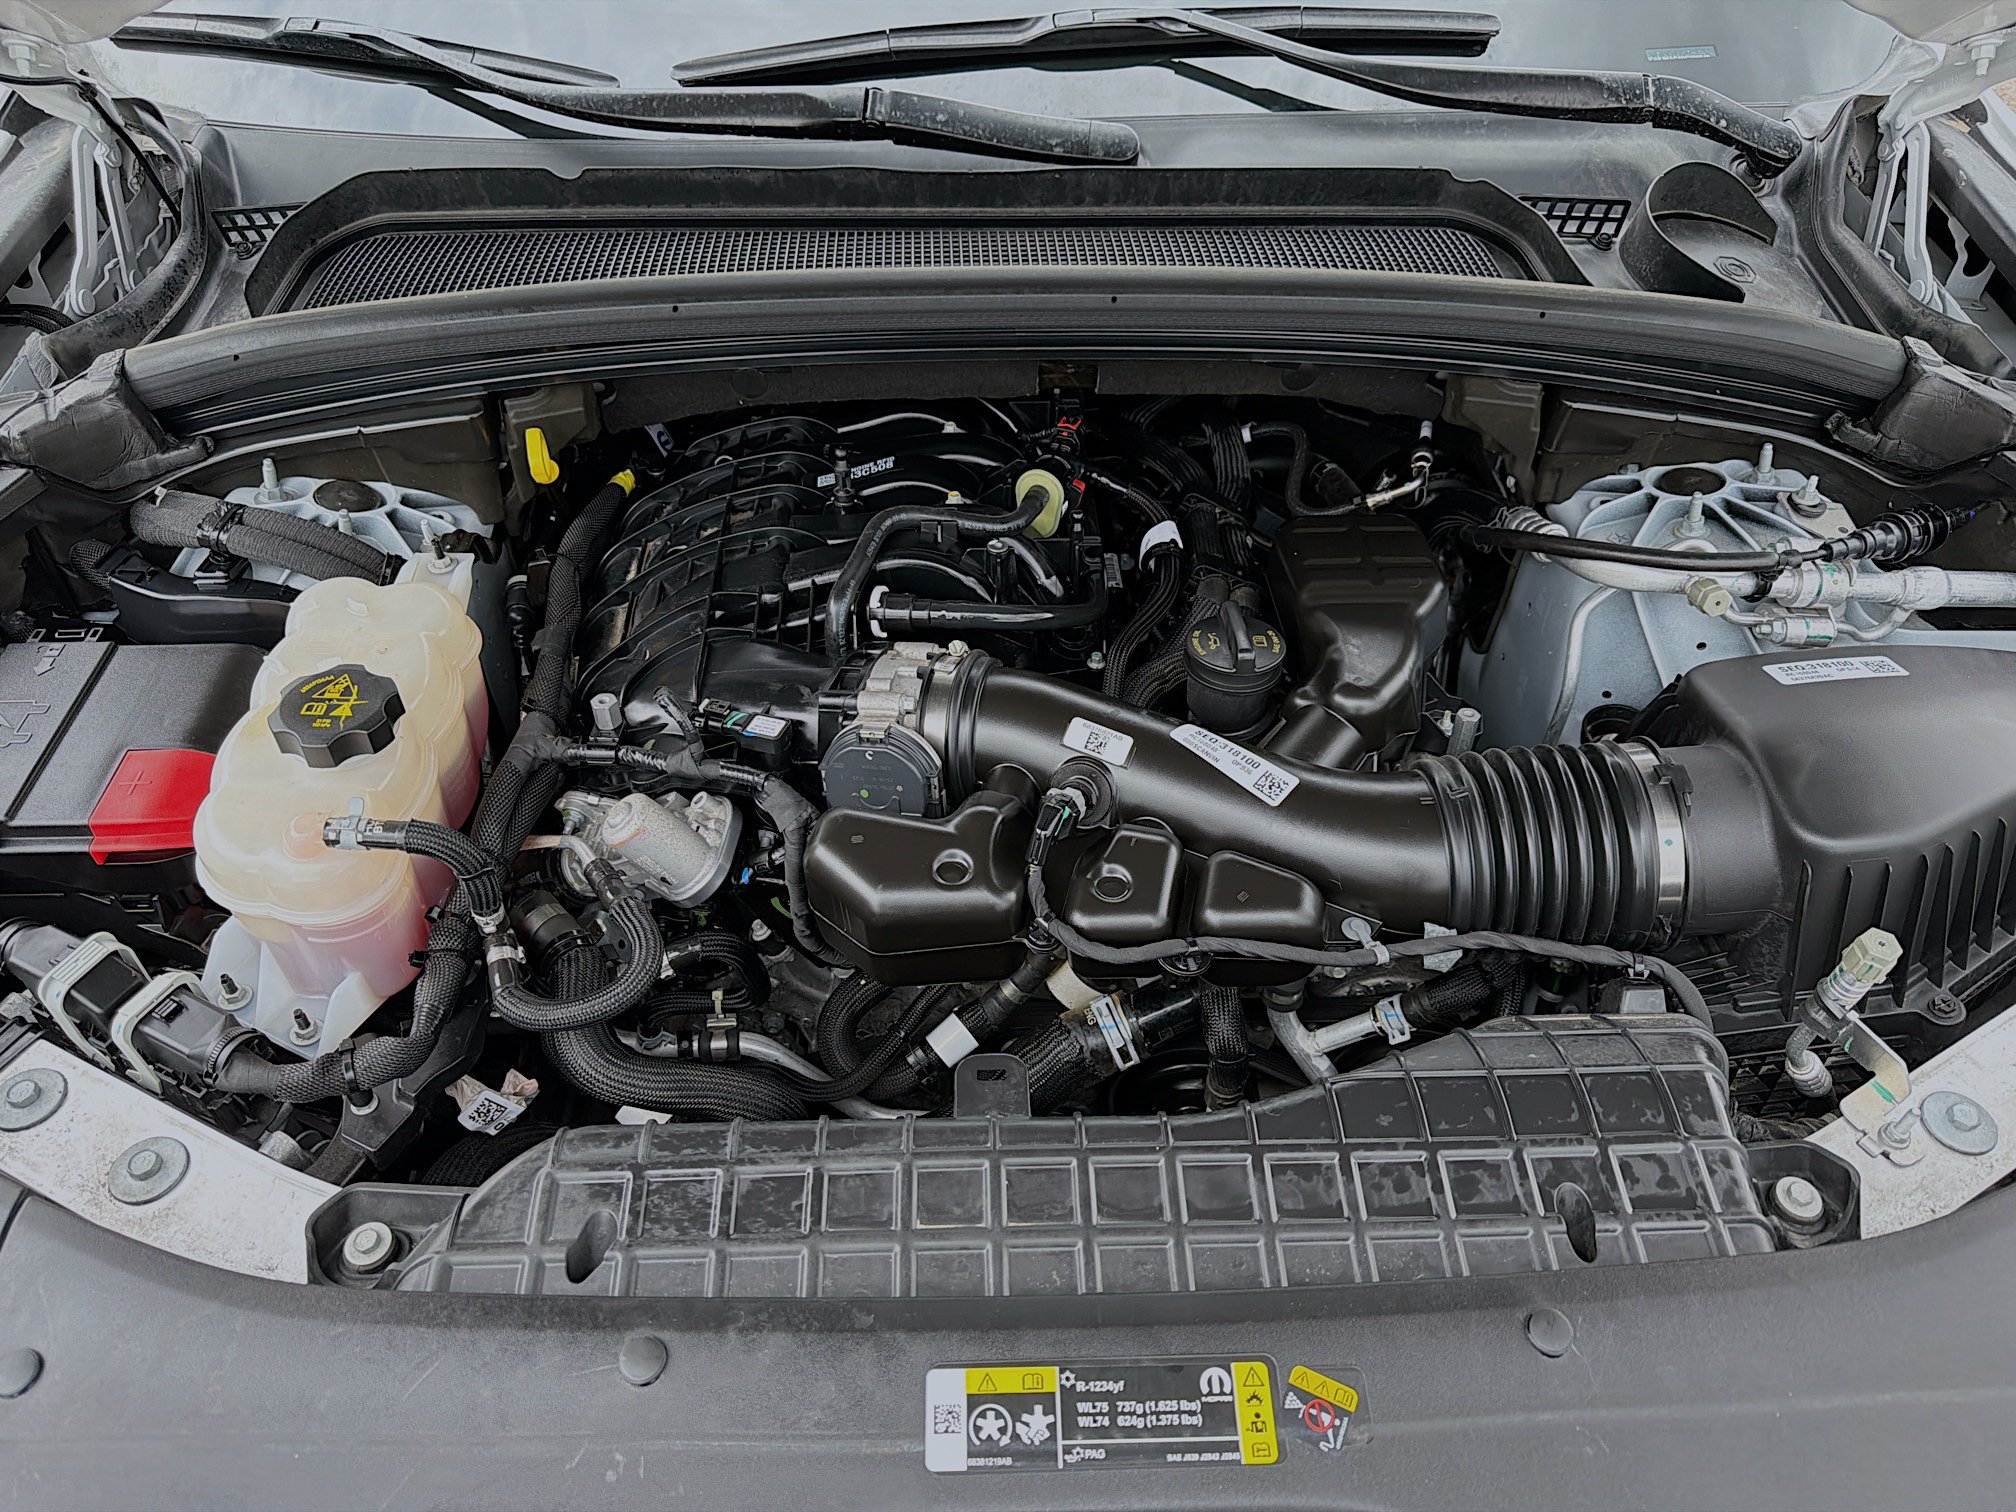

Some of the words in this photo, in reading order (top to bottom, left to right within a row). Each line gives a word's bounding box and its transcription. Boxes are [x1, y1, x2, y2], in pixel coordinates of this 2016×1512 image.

[877, 456, 896, 465] RFID
[1195, 729, 1261, 770] SEQ:318100
[1084, 1008, 1097, 1026] ENG
[1075, 1379, 1125, 1393] R-1234yf
[1076, 1401, 1109, 1413] WL75
[1116, 1401, 1145, 1414] 737g
[1145, 1400, 1179, 1414] (1.625
[1180, 1398, 1202, 1413] lbs)
[1077, 1415, 1110, 1427] WL74
[1116, 1415, 1145, 1428] 624g
[1146, 1414, 1180, 1428] (1.375
[1181, 1413, 1203, 1427] lbs)
[1085, 1449, 1106, 1459] PAG
